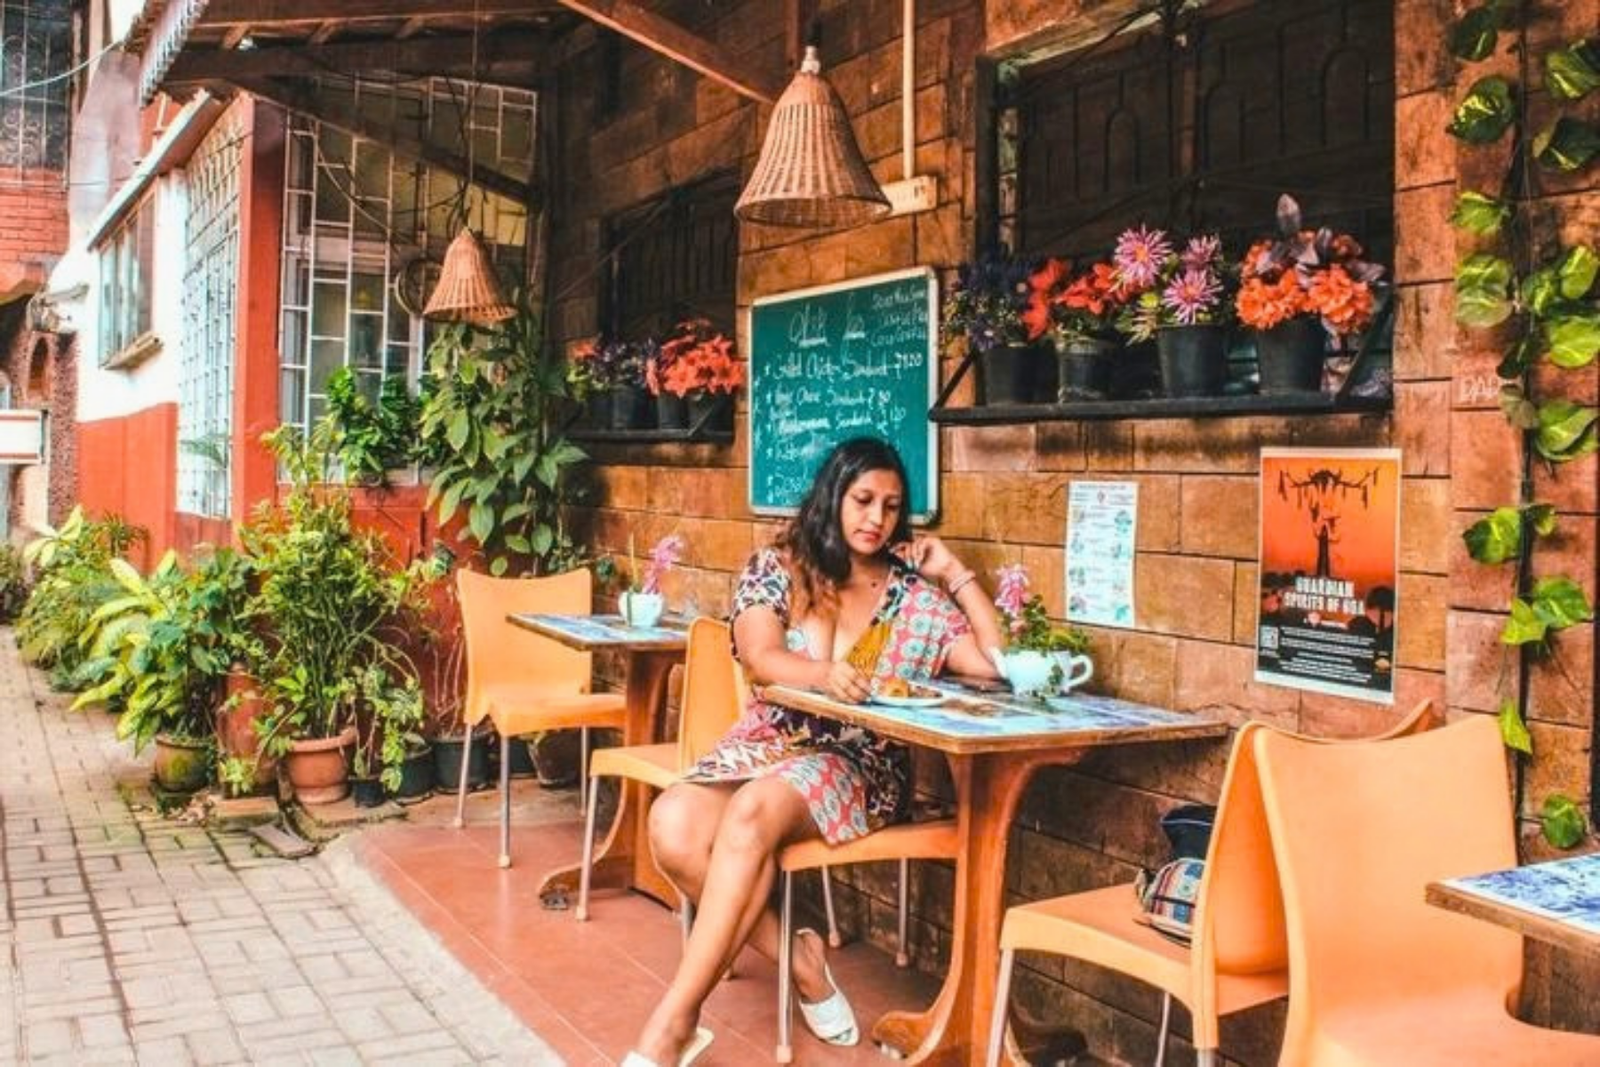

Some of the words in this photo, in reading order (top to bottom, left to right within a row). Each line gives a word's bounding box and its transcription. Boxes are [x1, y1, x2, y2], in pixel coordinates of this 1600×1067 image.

[1295, 576, 1355, 598] GUARDIAN
[1283, 591, 1324, 611] SPIRITS
[1327, 598, 1340, 613] OF
[1342, 599, 1366, 615] GOA
